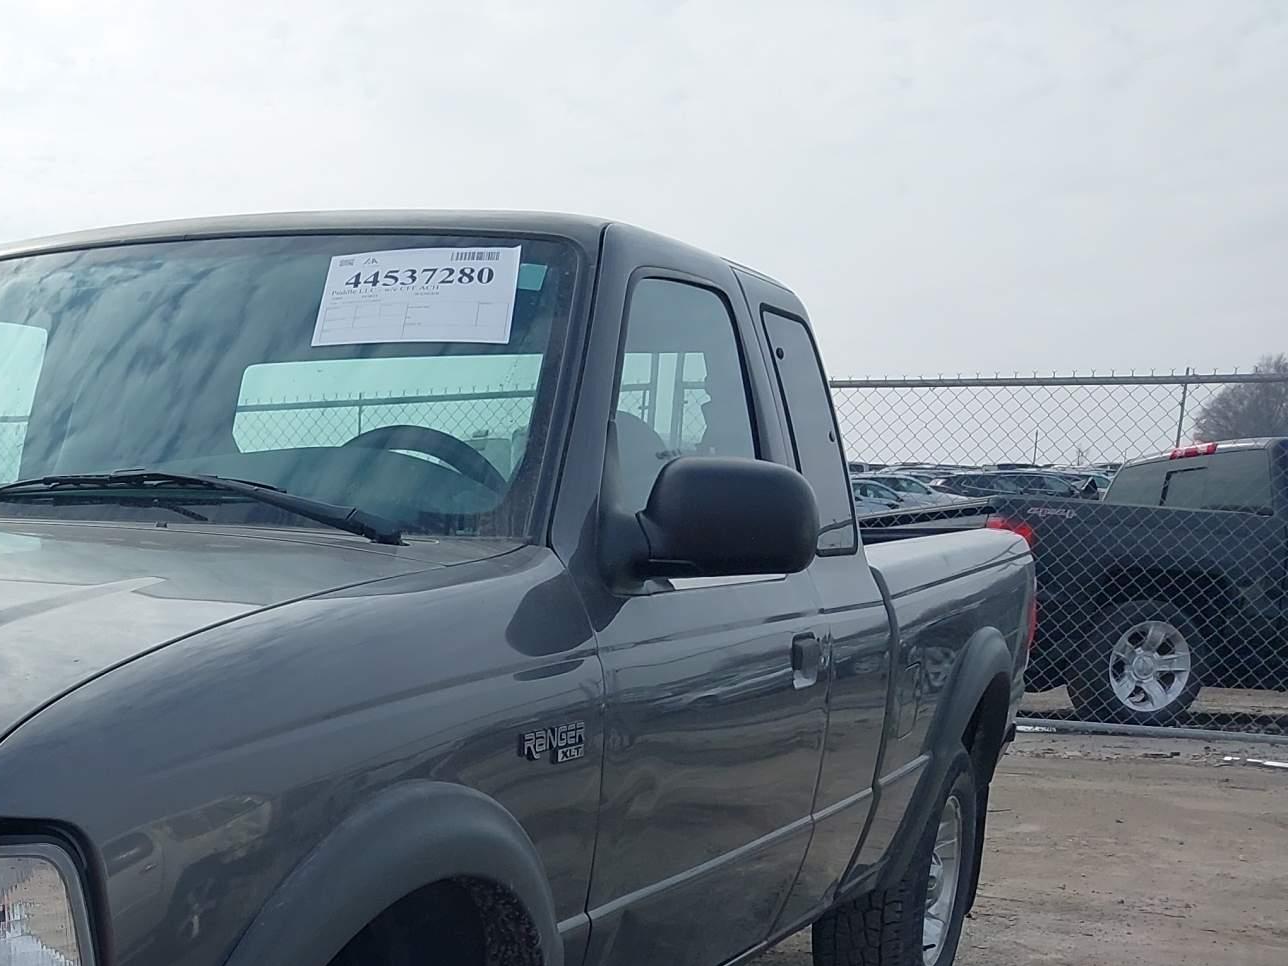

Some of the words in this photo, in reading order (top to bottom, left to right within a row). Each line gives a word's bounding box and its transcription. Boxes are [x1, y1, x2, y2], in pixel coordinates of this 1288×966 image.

[345, 266, 495, 288] 44537280
[524, 721, 585, 759] RANGER
[559, 747, 583, 761] XLT
